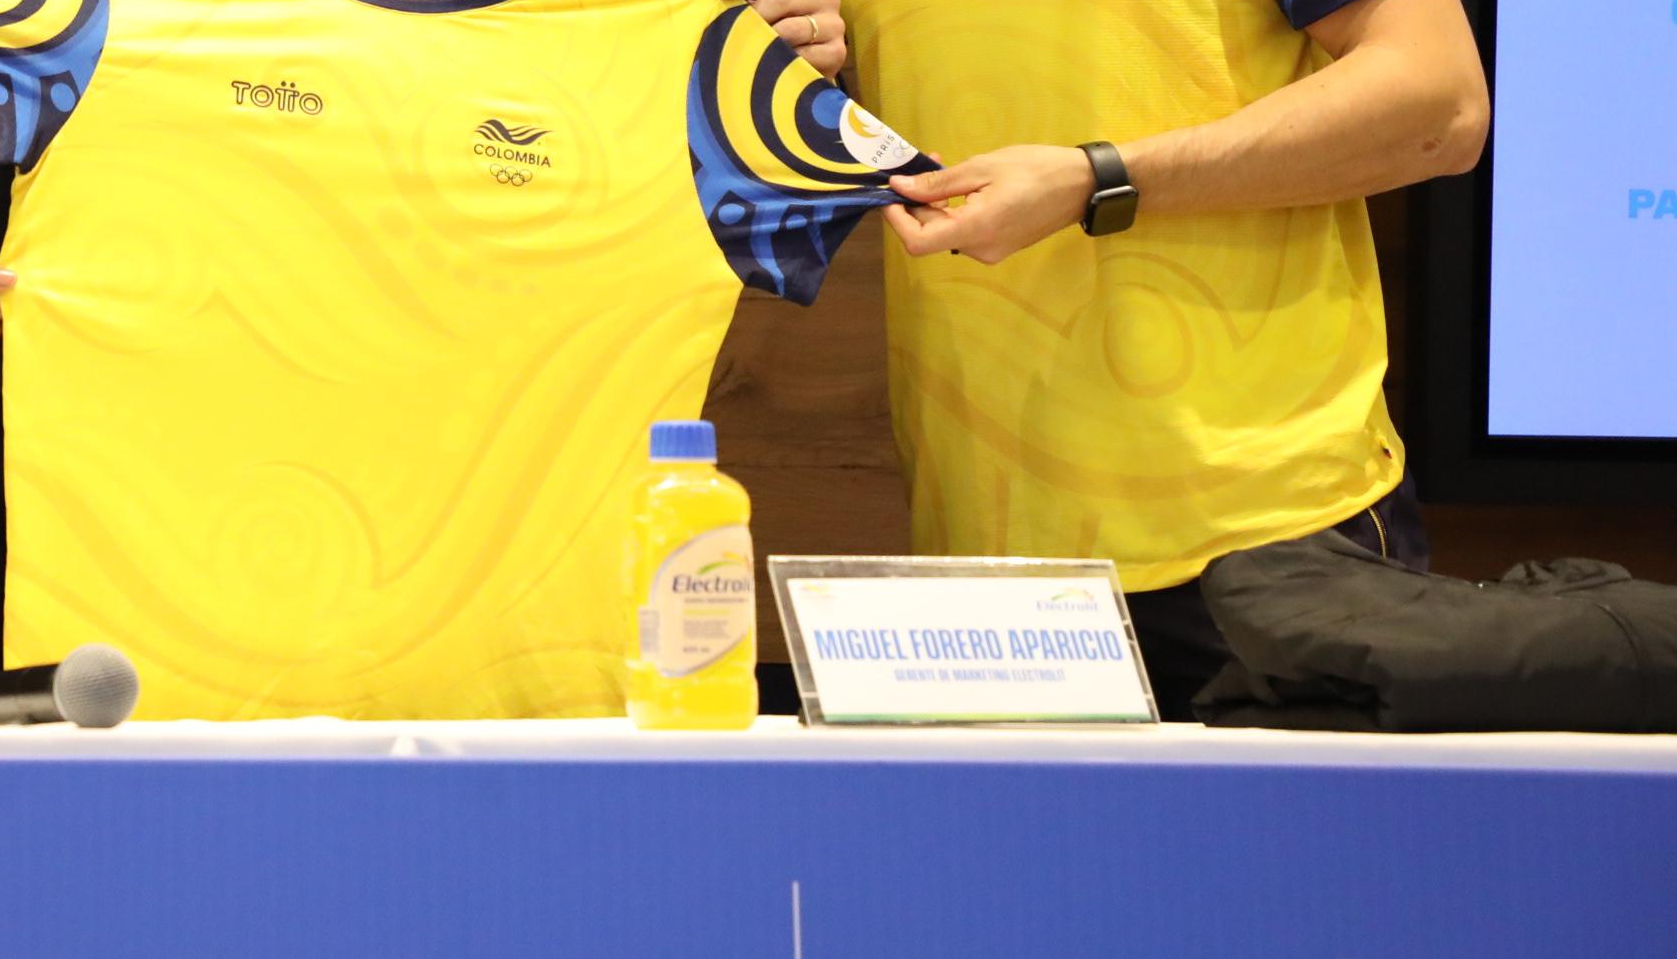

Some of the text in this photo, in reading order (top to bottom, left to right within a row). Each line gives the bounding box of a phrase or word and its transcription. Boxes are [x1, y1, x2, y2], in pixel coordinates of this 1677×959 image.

[473, 143, 551, 168] COLOMBIA
[872, 134, 895, 163] PARIS
[1628, 188, 1677, 219] PA
[813, 629, 1123, 661] MIGUEL FORERO APARICIO
[1012, 668, 1066, 682] ELECTROLIT
